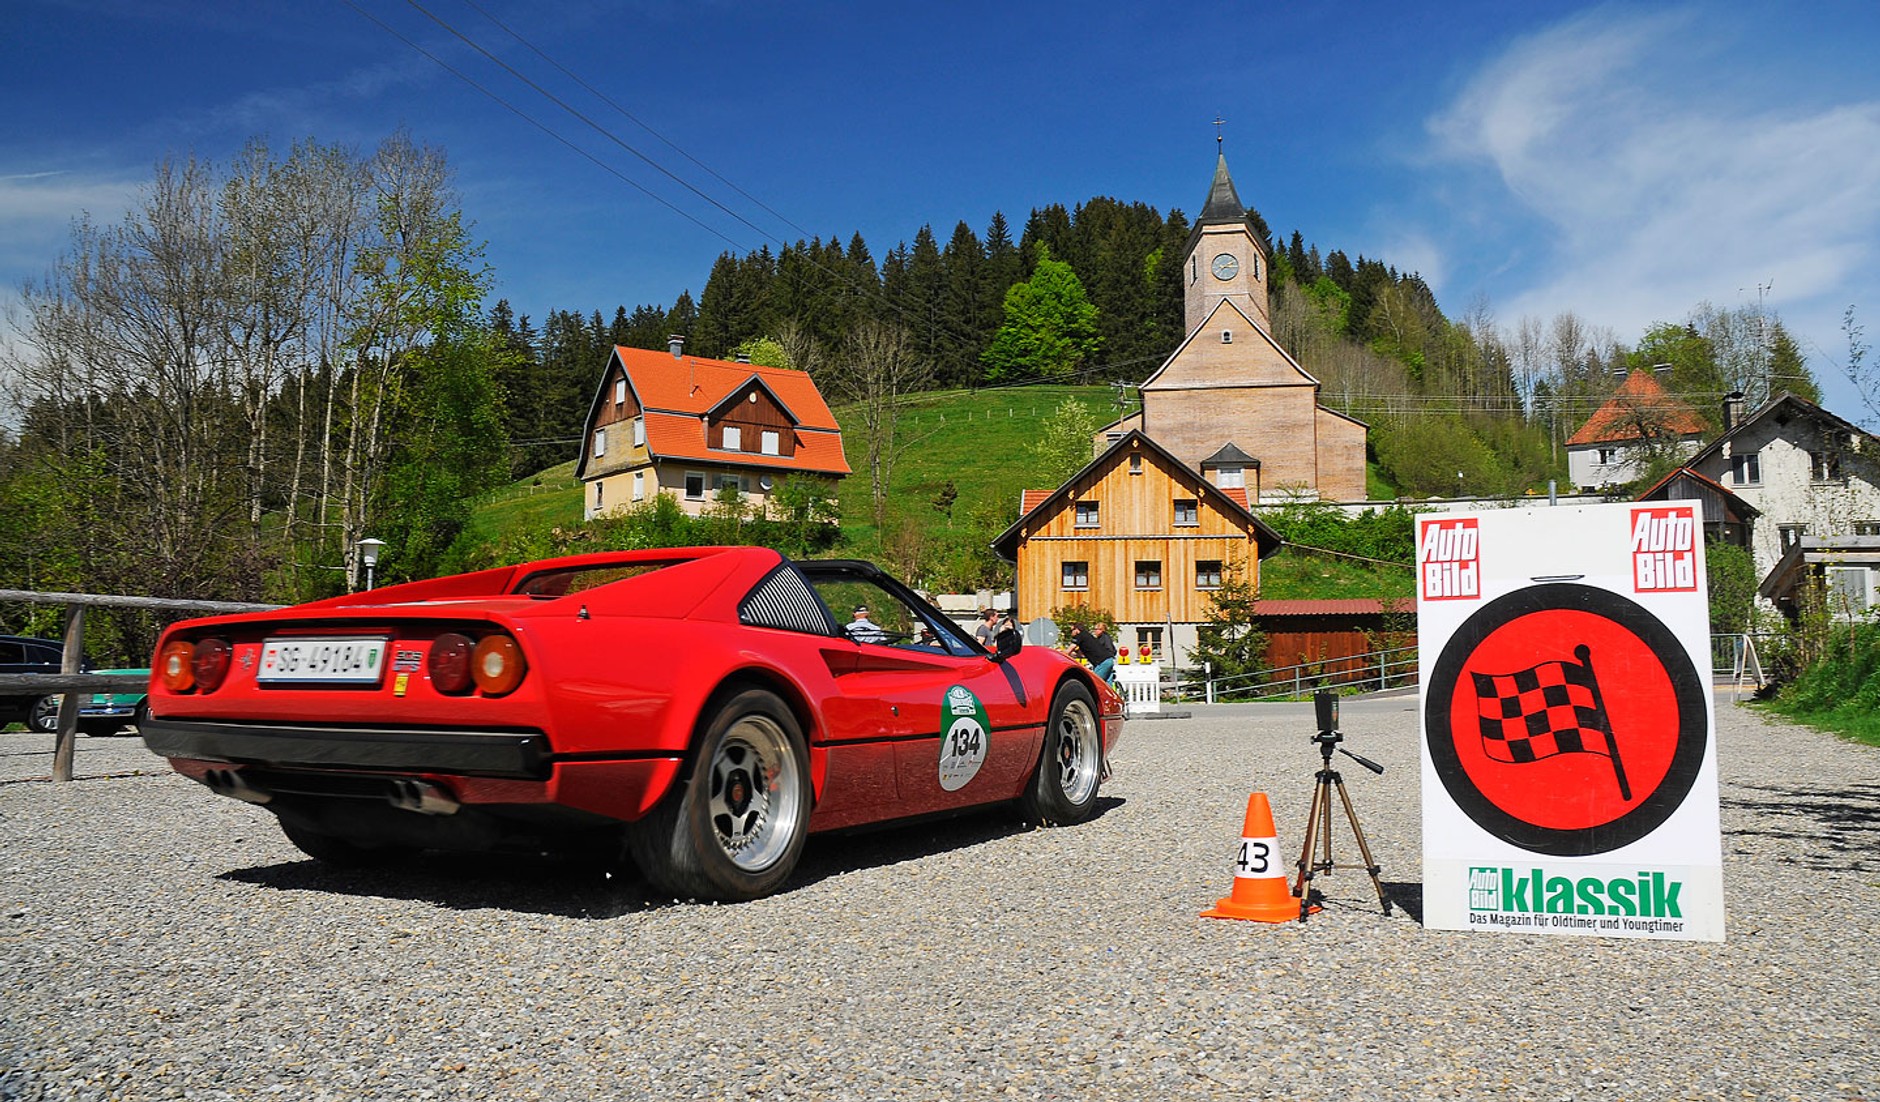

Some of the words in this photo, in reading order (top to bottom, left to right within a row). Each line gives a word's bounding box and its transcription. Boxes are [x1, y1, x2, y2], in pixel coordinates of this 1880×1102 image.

[1421, 522, 1479, 563] Auto
[1632, 511, 1694, 553] Auto
[1425, 561, 1478, 598] Bild
[1635, 552, 1695, 590] Bild
[951, 728, 980, 758] 134
[1237, 842, 1270, 873] 43
[1469, 868, 1498, 891] Auto
[1501, 868, 1682, 918] klassik
[1470, 890, 1498, 910] Bild
[1469, 912, 1487, 925] Das
[1489, 913, 1532, 928] Magazin
[1534, 914, 1549, 927] für
[1551, 915, 1597, 929] Oldtimer
[1600, 917, 1620, 930] und
[1622, 918, 1684, 933] Youngtimer
